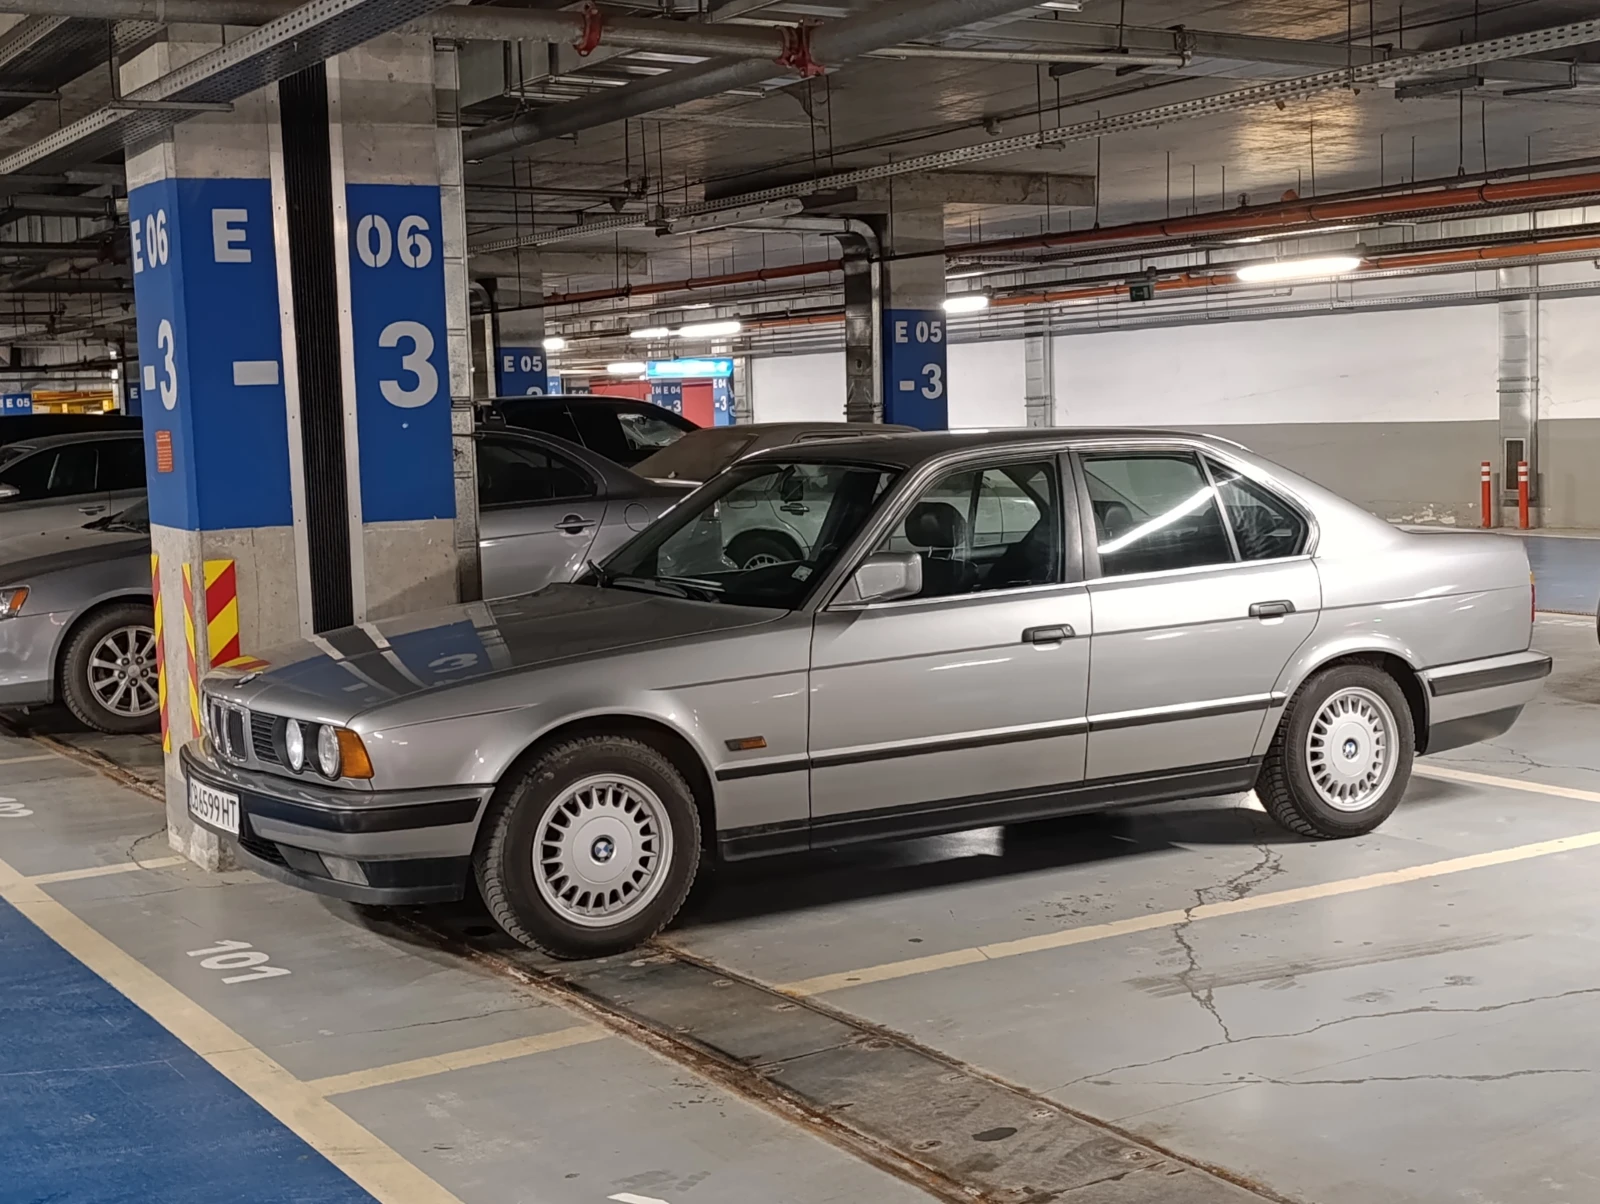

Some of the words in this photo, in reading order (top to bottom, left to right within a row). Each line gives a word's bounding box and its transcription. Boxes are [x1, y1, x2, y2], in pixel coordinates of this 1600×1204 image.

[131, 219, 144, 274] E
[146, 208, 169, 269] 06
[211, 208, 252, 263] E
[356, 214, 432, 268] 06
[895, 321, 909, 343] E
[915, 320, 943, 343] 05
[378, 320, 439, 409] 3
[503, 355, 515, 372] E
[520, 355, 543, 372] 05
[130, 387, 139, 399] E
[663, 386, 669, 394] E
[670, 386, 681, 394] 04
[713, 379, 718, 389] E
[6, 398, 14, 408] E
[16, 397, 30, 408] 05
[186, 939, 292, 985] 101
